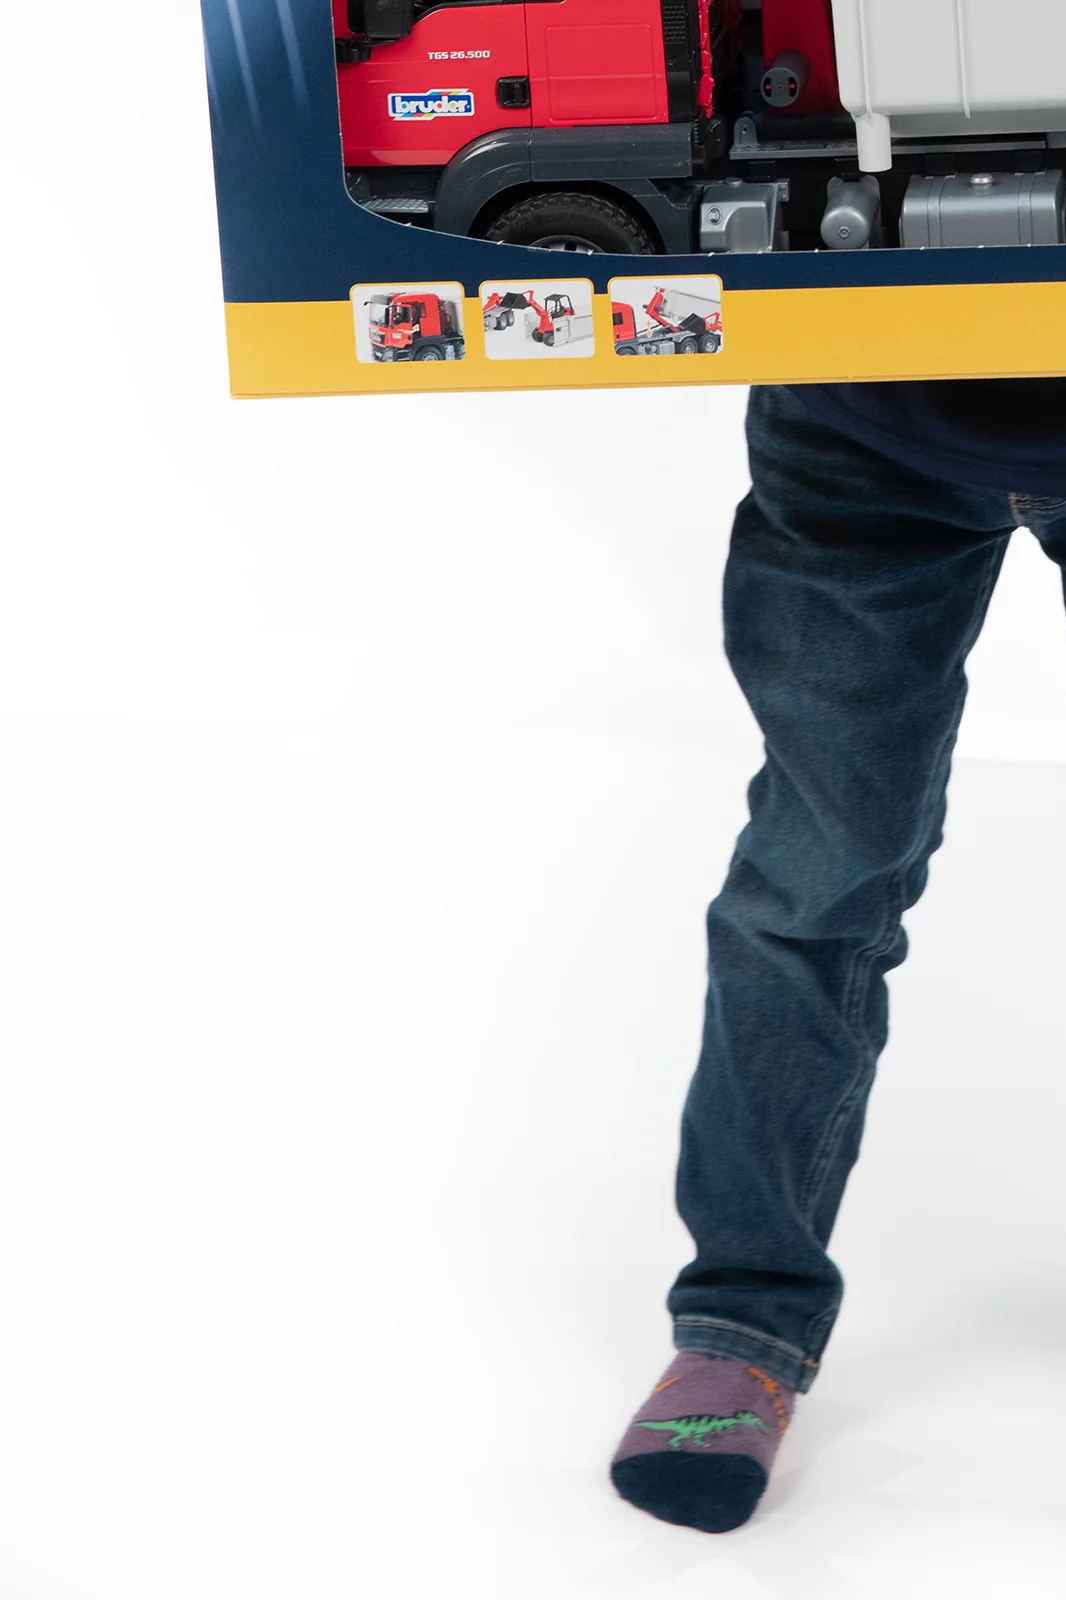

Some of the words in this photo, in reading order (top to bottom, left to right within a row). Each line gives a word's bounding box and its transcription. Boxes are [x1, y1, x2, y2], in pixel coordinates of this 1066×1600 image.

[427, 51, 449, 60] TGS
[450, 50, 490, 59] 26.500
[394, 96, 468, 113] bruder
